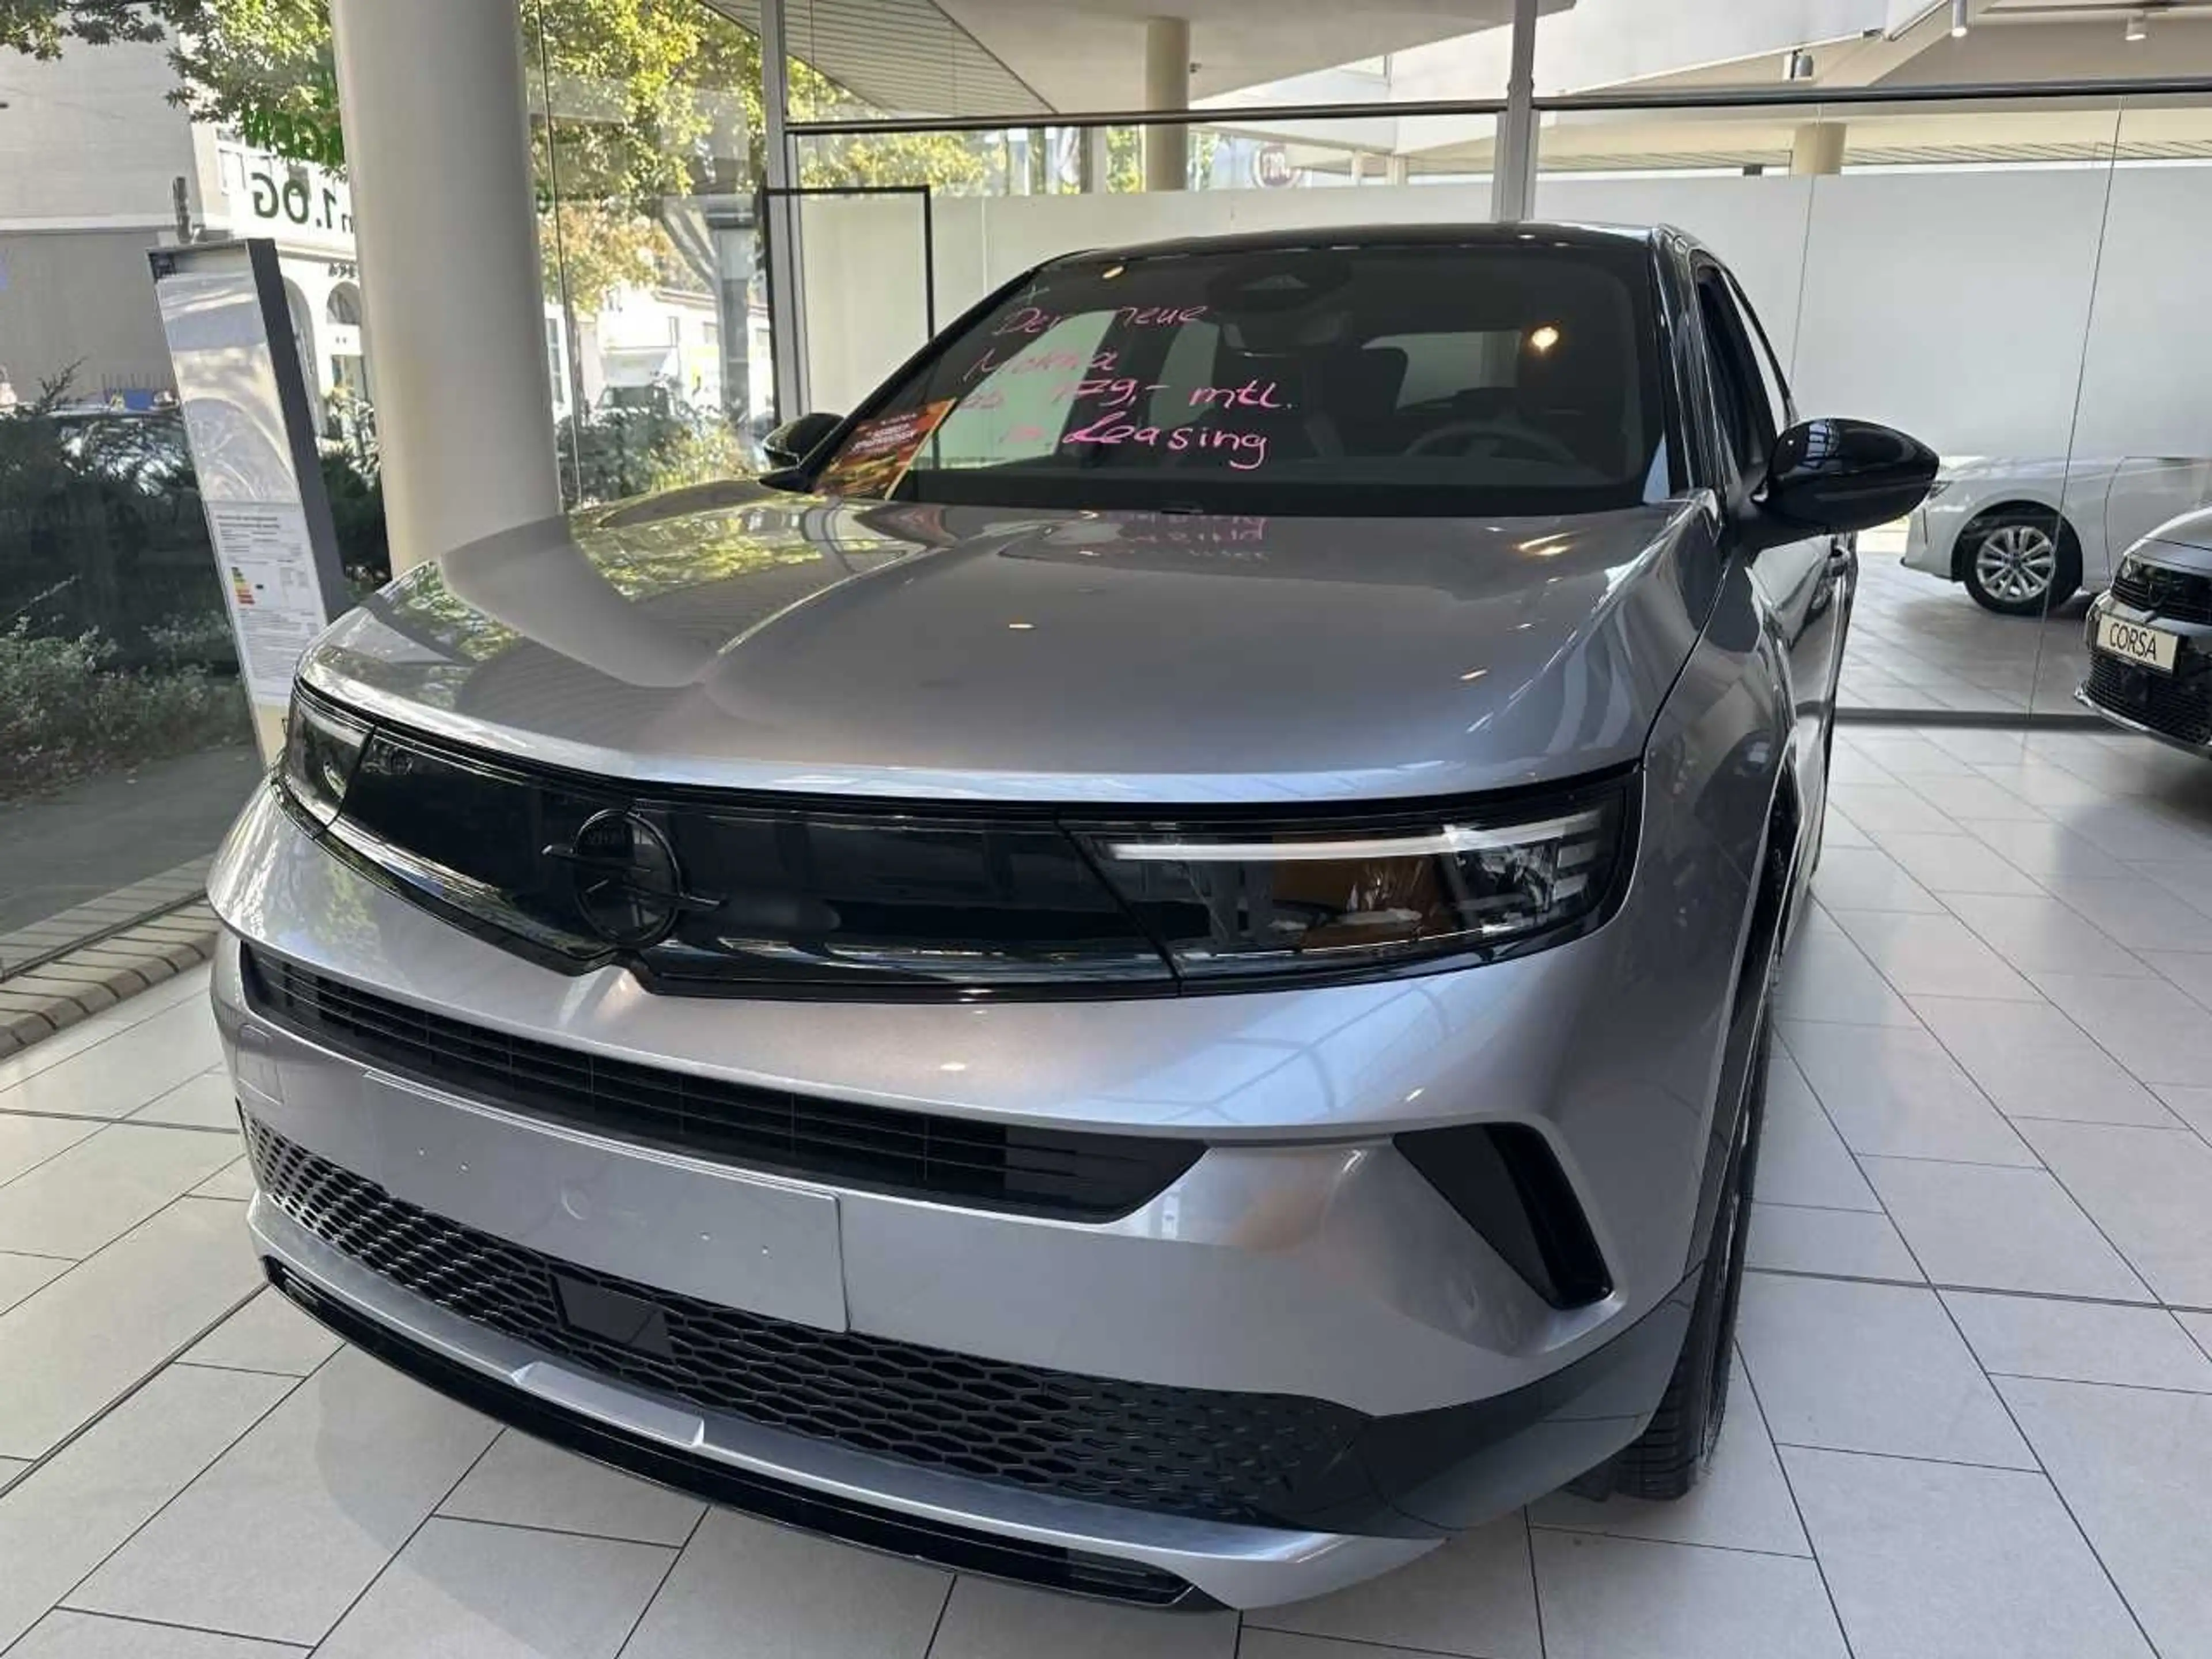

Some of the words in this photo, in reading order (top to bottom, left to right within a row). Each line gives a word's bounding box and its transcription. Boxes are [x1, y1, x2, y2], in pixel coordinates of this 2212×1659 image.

[1116, 305, 1208, 328] neue
[1062, 410, 1267, 469] Leasing
[2109, 622, 2157, 661] CORSA
